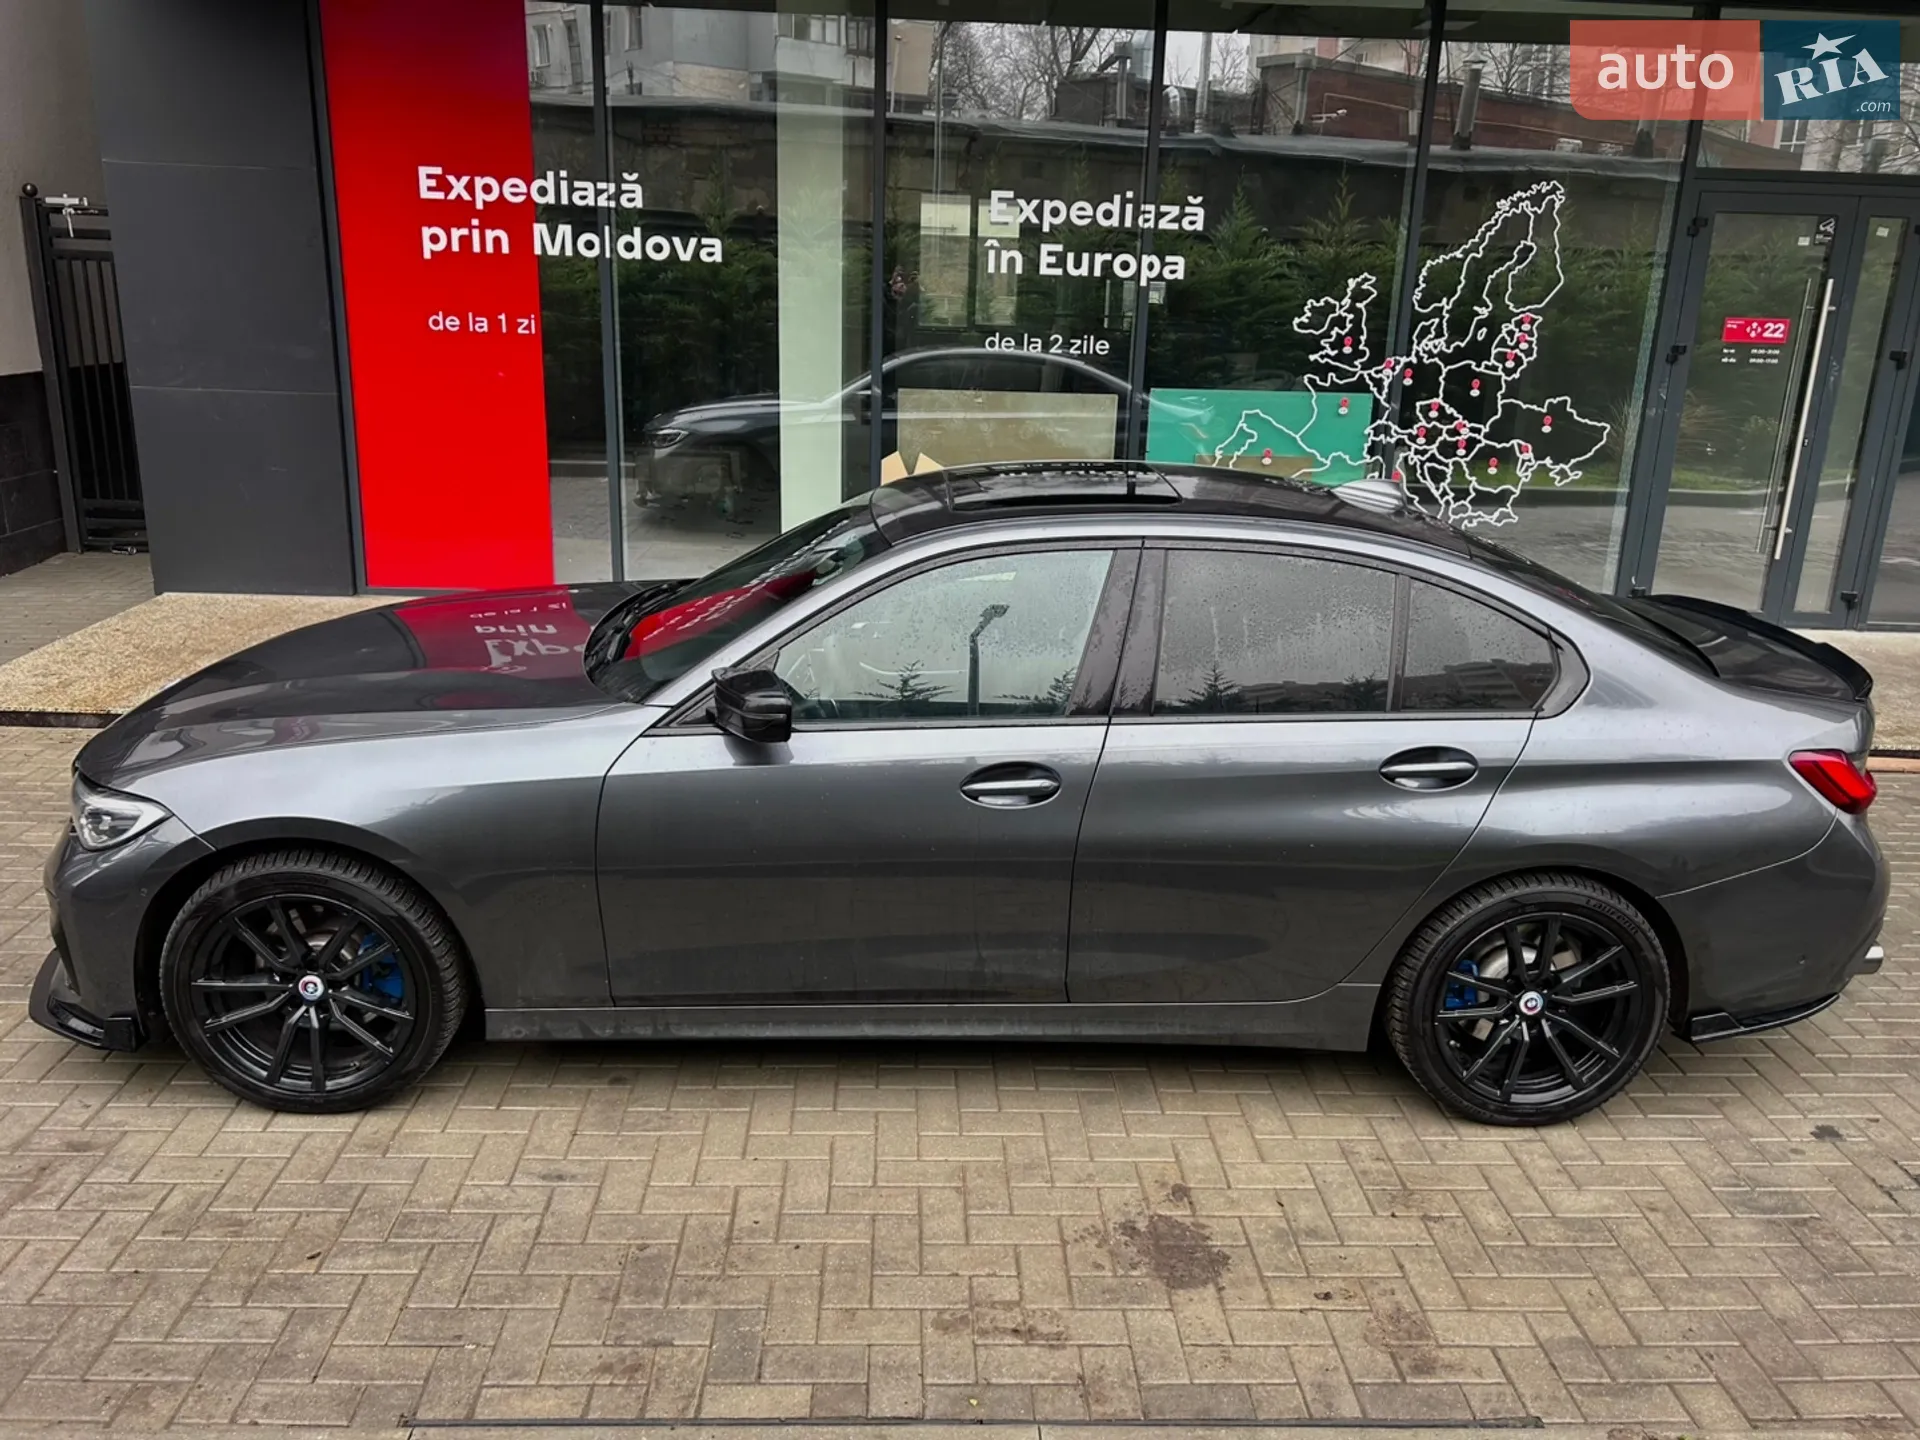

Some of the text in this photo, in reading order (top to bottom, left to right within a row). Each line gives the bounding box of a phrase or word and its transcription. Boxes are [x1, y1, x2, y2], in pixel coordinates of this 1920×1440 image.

[418, 166, 643, 210] Expediază
[990, 190, 1205, 233] Expediază
[421, 218, 723, 263] prin Moldova
[984, 239, 1186, 287] în Europa
[428, 311, 536, 334] de la 1 zi
[984, 332, 1110, 355] de la 2 zile
[1762, 322, 1785, 338] 22
